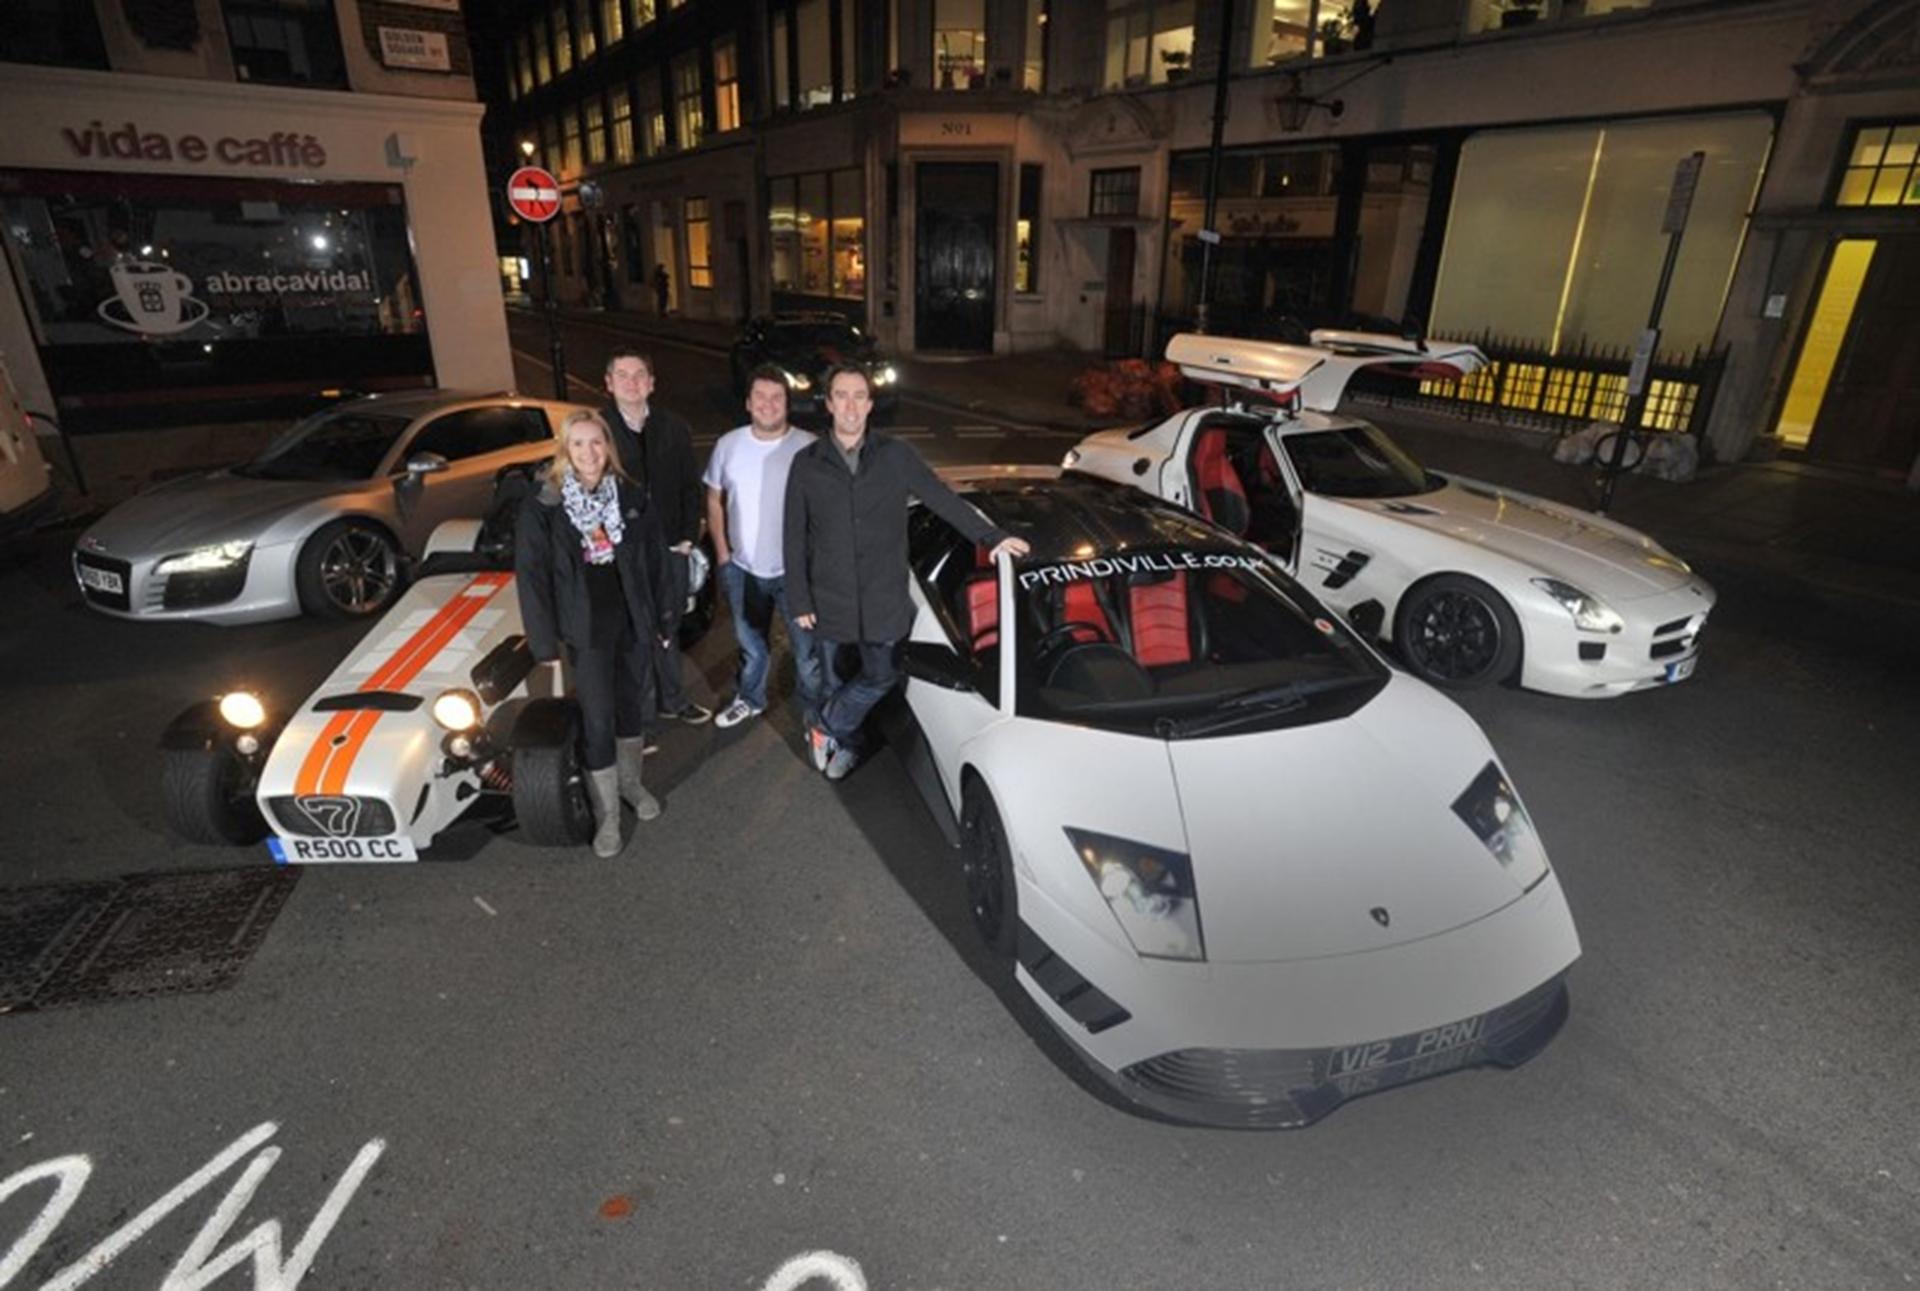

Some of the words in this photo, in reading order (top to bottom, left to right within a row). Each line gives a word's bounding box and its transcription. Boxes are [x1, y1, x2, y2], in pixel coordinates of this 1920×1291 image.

[62, 120, 173, 161] vida
[177, 133, 208, 162] e
[215, 131, 327, 168] caffè
[304, 797, 354, 834] 7
[295, 838, 363, 860] R500
[368, 838, 403, 859] CC
[1341, 1041, 1392, 1072] V12
